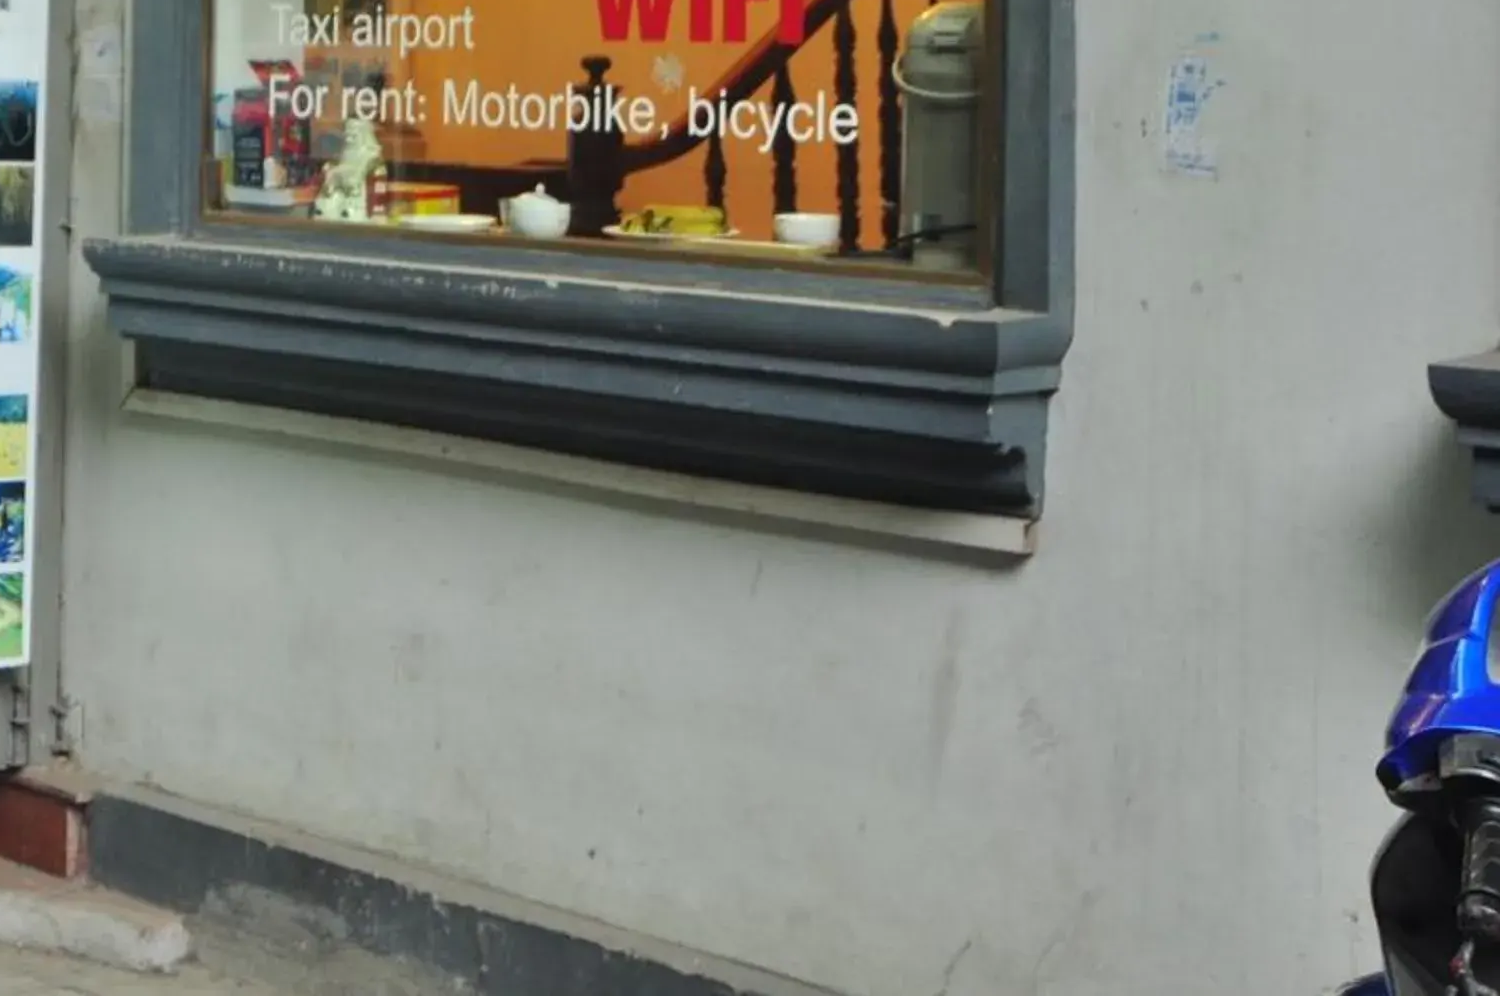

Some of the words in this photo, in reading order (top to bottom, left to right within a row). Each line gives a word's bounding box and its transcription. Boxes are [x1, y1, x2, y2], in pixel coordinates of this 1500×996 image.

[270, 3, 340, 47] Taxi
[351, 5, 476, 59] airport
[267, 73, 328, 120] For
[341, 79, 428, 124] rent:
[442, 78, 670, 140] Motorbike,
[687, 86, 860, 153] bicycle
